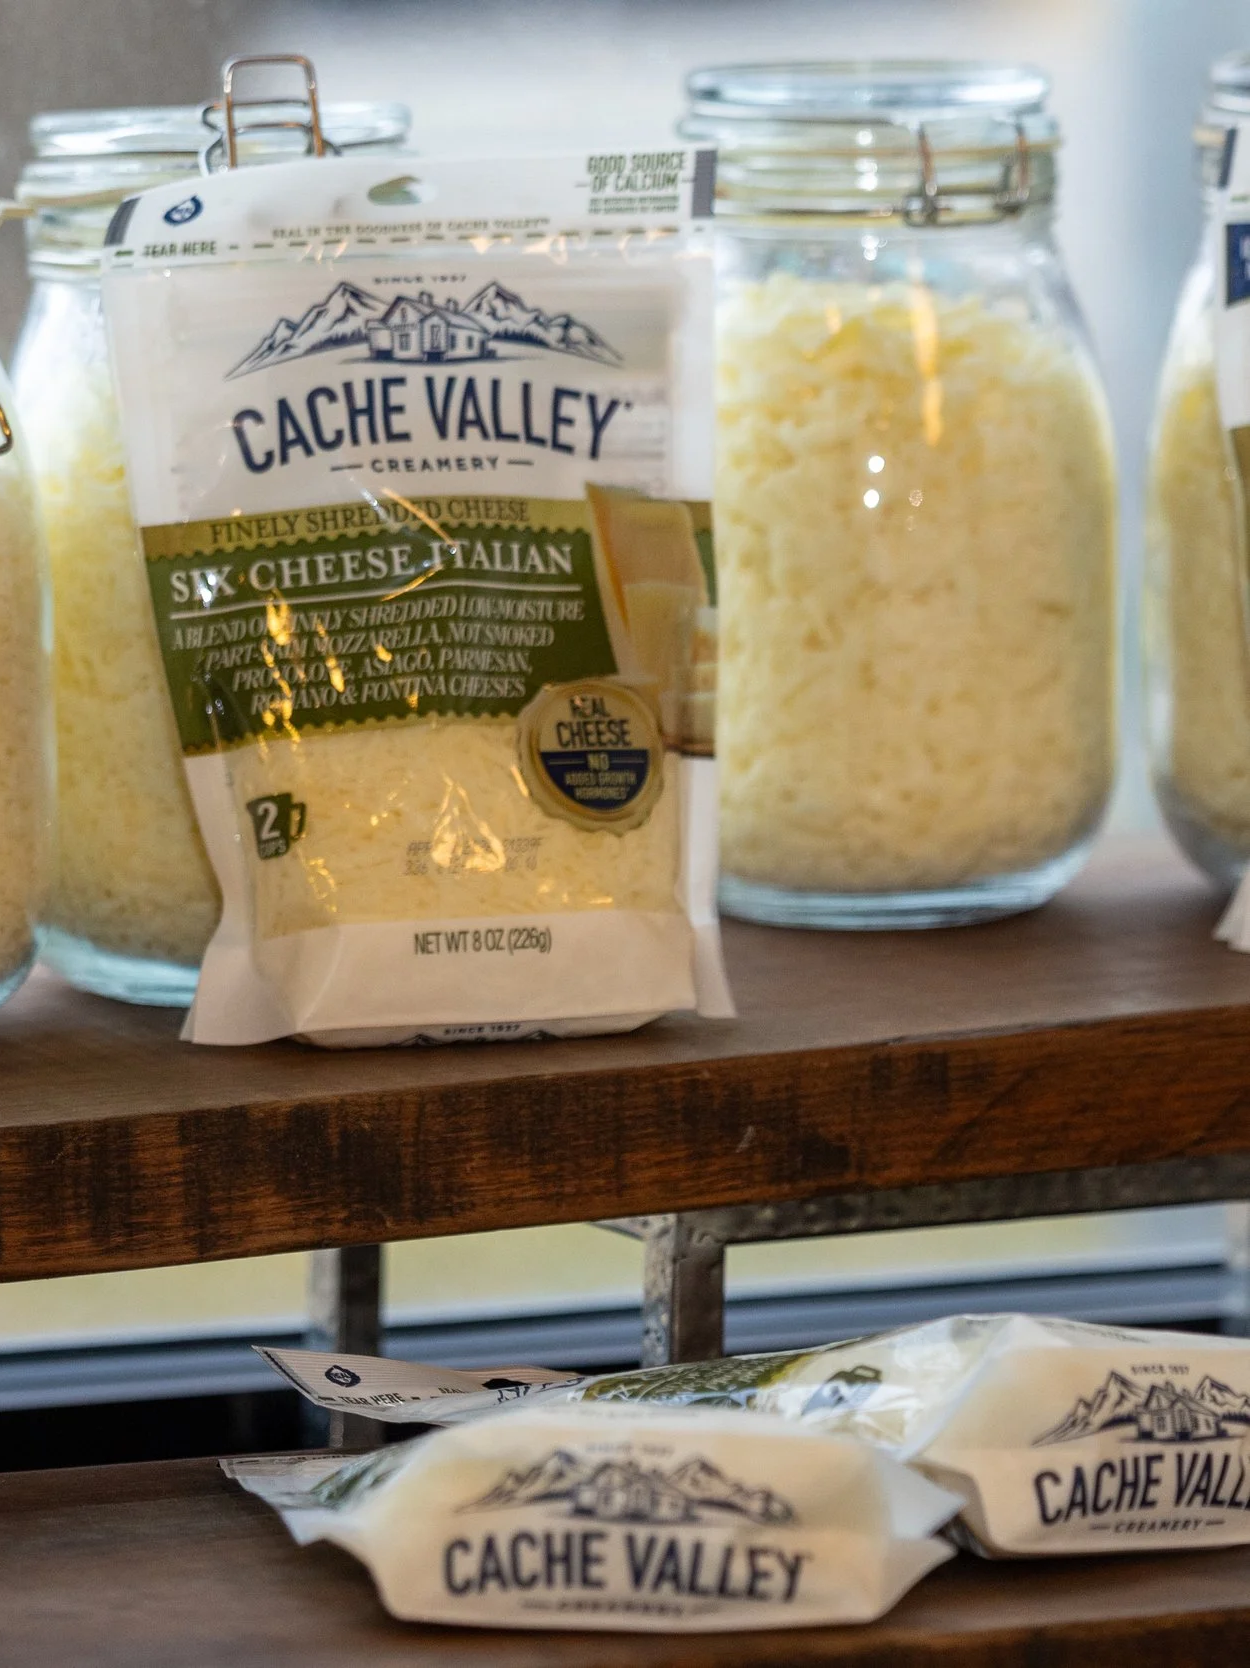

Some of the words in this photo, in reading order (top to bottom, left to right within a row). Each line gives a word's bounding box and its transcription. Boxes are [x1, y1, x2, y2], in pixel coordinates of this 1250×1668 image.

[182, 240, 217, 256] HERE
[232, 377, 412, 475] CACHE
[370, 455, 500, 473] CREAMERY
[210, 513, 300, 544] FINELY
[447, 499, 531, 523] CHEESE
[170, 565, 238, 604] SIX
[248, 544, 416, 592] CHEESE
[429, 538, 574, 576] ITALIAN
[184, 618, 247, 649] BLEND
[249, 615, 272, 637] O
[279, 607, 348, 633] INELY
[350, 595, 457, 629] SHREDDED
[205, 635, 308, 671] PART-KIM
[484, 624, 556, 648] SMOKED
[449, 675, 528, 699] CHEESES
[555, 718, 632, 748] CHEESE
[257, 802, 279, 840] 2
[414, 932, 442, 955] NET
[445, 930, 470, 953] WT
[472, 929, 483, 953] 8
[484, 928, 506, 951] OZ
[507, 926, 553, 956] (226g)
[338, 1395, 372, 1407] TEAR
[370, 1392, 407, 1407] HERE
[1034, 1453, 1165, 1526] CACHE
[1175, 1452, 1250, 1512] VALL
[1113, 1519, 1203, 1534] CREAMERY
[443, 1529, 610, 1598] CACHE
[625, 1532, 807, 1602] VALLEY
